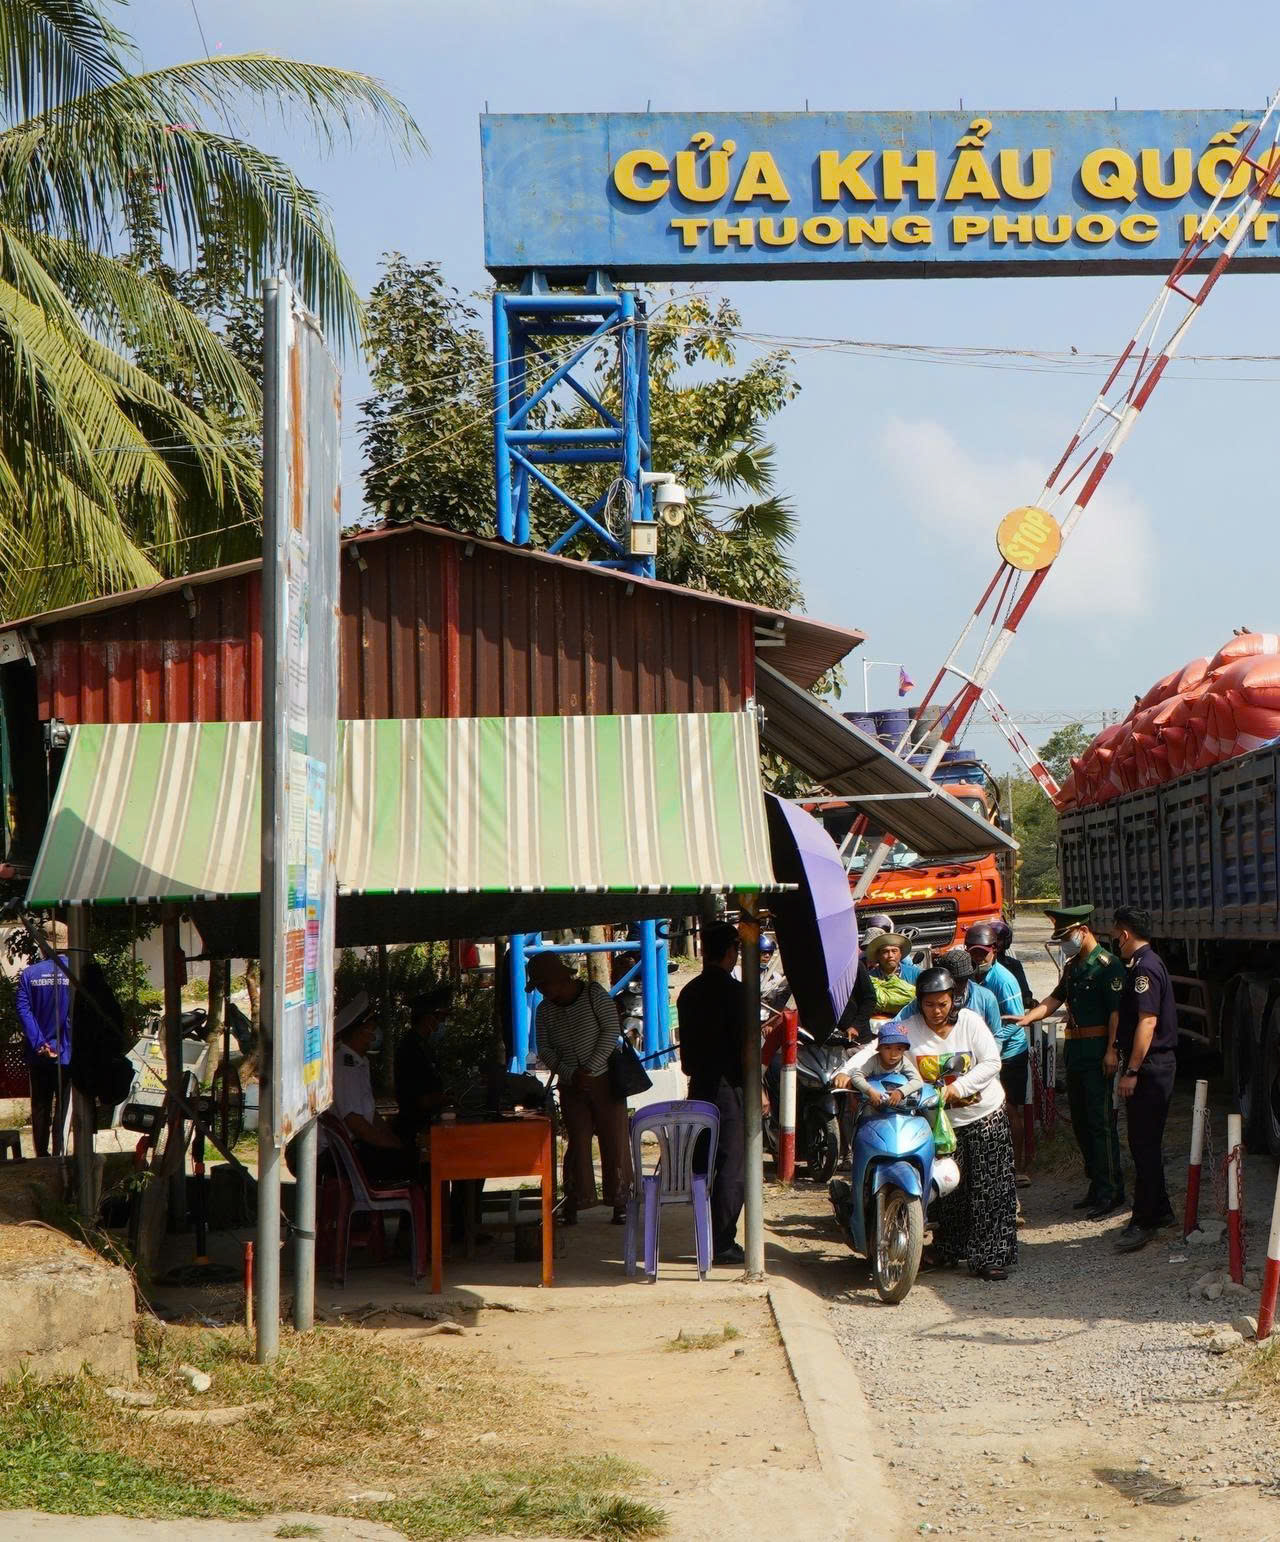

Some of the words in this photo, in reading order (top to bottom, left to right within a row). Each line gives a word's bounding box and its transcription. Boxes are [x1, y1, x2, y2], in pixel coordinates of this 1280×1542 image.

[615, 132, 790, 203] CỬA
[819, 118, 1052, 202] KHẨU
[671, 217, 932, 247] THUONG
[953, 214, 1159, 244] PHUOC
[1006, 510, 1052, 565] STOP
